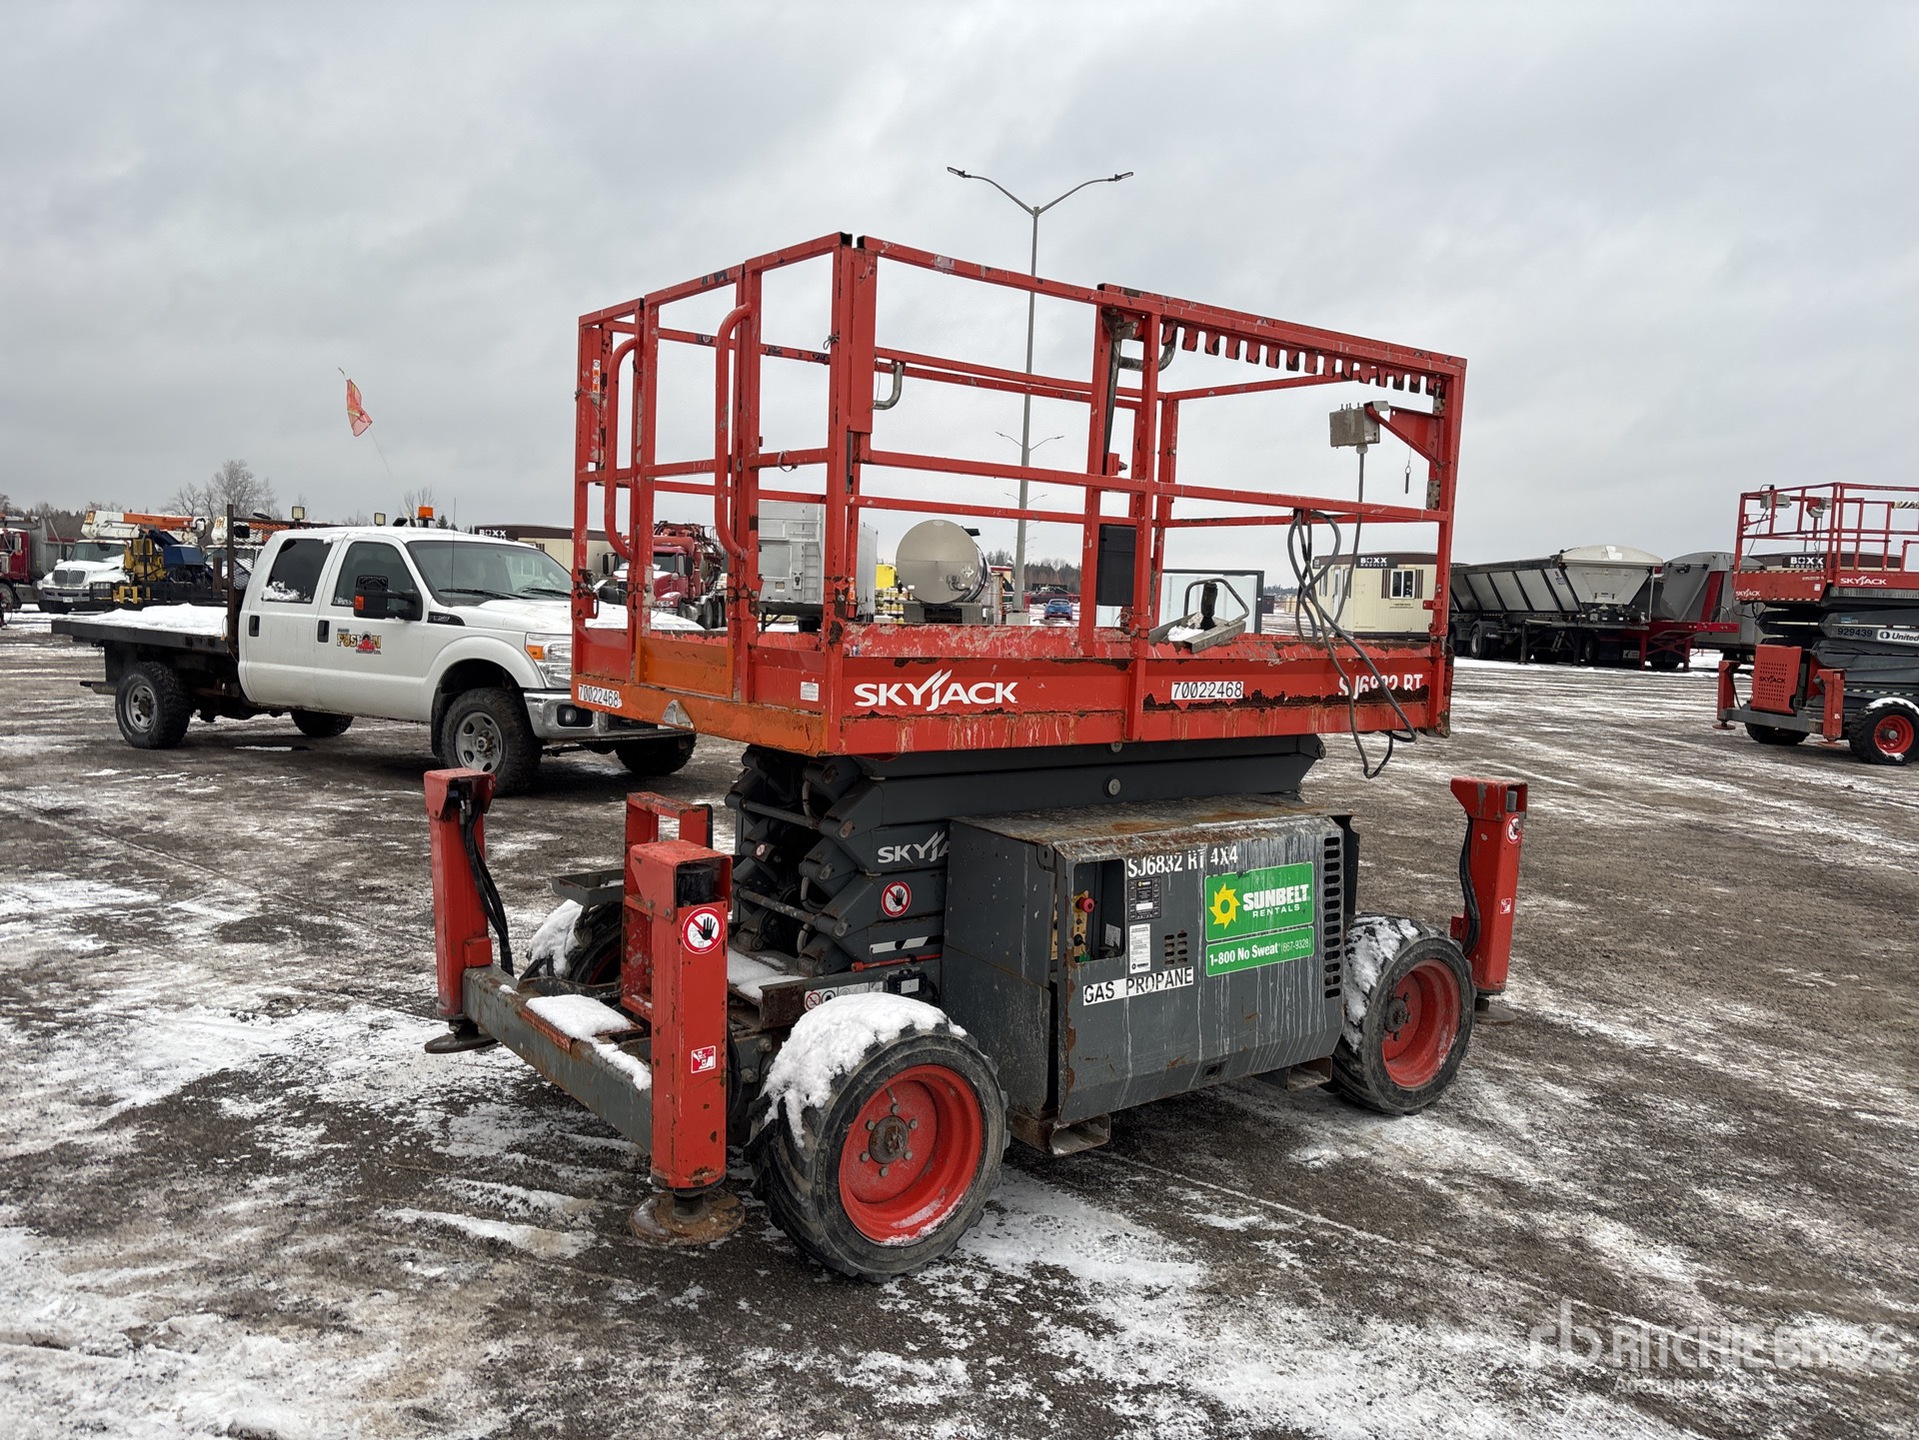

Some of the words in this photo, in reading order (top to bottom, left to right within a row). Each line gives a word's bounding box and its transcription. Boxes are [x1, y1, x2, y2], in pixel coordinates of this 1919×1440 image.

[479, 529, 507, 537] BOXX
[1790, 556, 1824, 565] BOXX
[1840, 575, 1887, 586] SKYJACK
[1735, 588, 1761, 597] SKYJACK
[1837, 627, 1873, 638] 929439
[1892, 632, 1919, 642] United
[1403, 673, 1424, 691] RT
[1758, 675, 1786, 684] SKYJACK
[579, 684, 620, 707] 70022468
[854, 669, 1018, 711] SKYJACK
[1173, 681, 1243, 699] 70022468
[1127, 852, 1183, 878] SJ6832
[1210, 845, 1238, 866] 4X4
[1243, 884, 1309, 911] SUNBELT
[1252, 904, 1300, 918] RENTALS
[1209, 949, 1236, 967] 1-800
[1237, 946, 1250, 961] No
[1251, 942, 1279, 958] Sweat
[1084, 981, 1115, 1003] GAS
[1126, 966, 1193, 996] PROPANE
